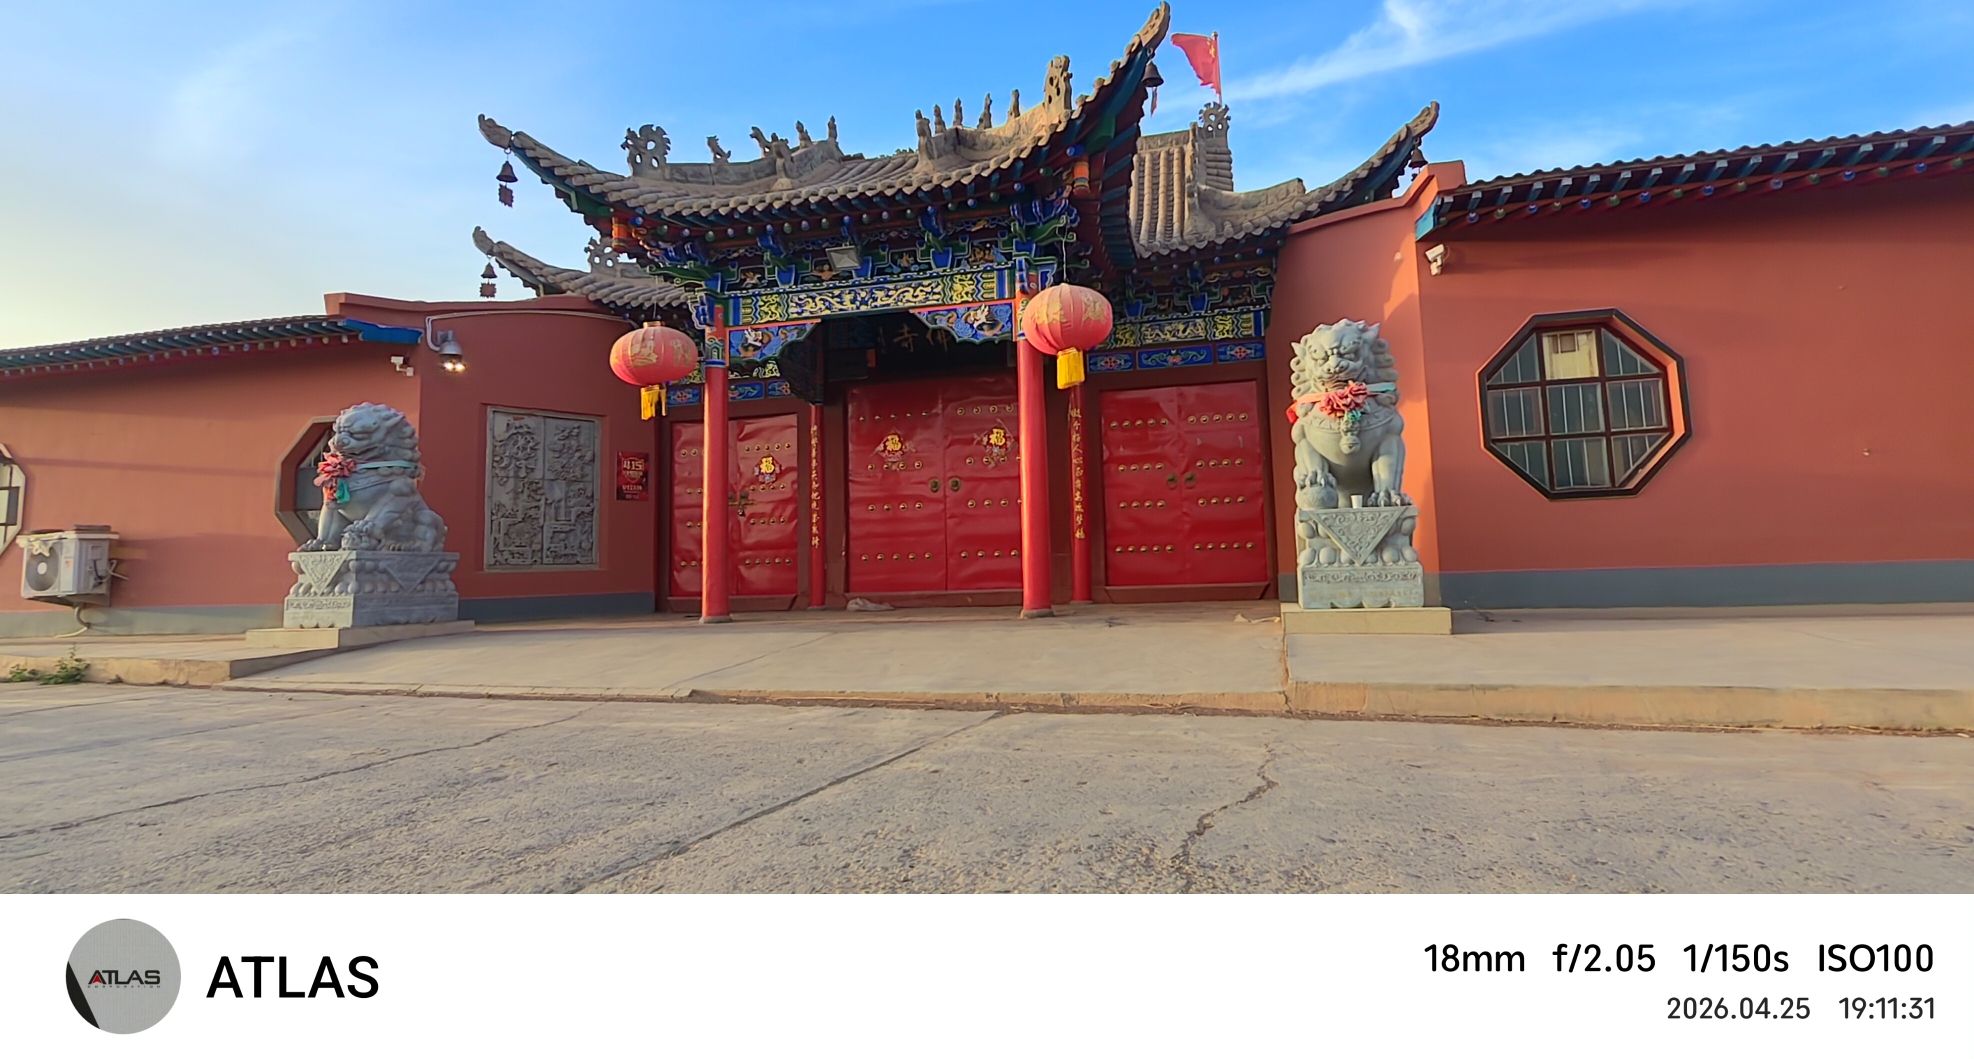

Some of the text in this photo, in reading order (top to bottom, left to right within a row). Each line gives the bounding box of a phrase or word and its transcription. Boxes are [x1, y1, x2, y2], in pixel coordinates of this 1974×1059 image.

[886, 433, 902, 451] 福
[989, 428, 1006, 445] 福
[759, 456, 775, 473] 福
